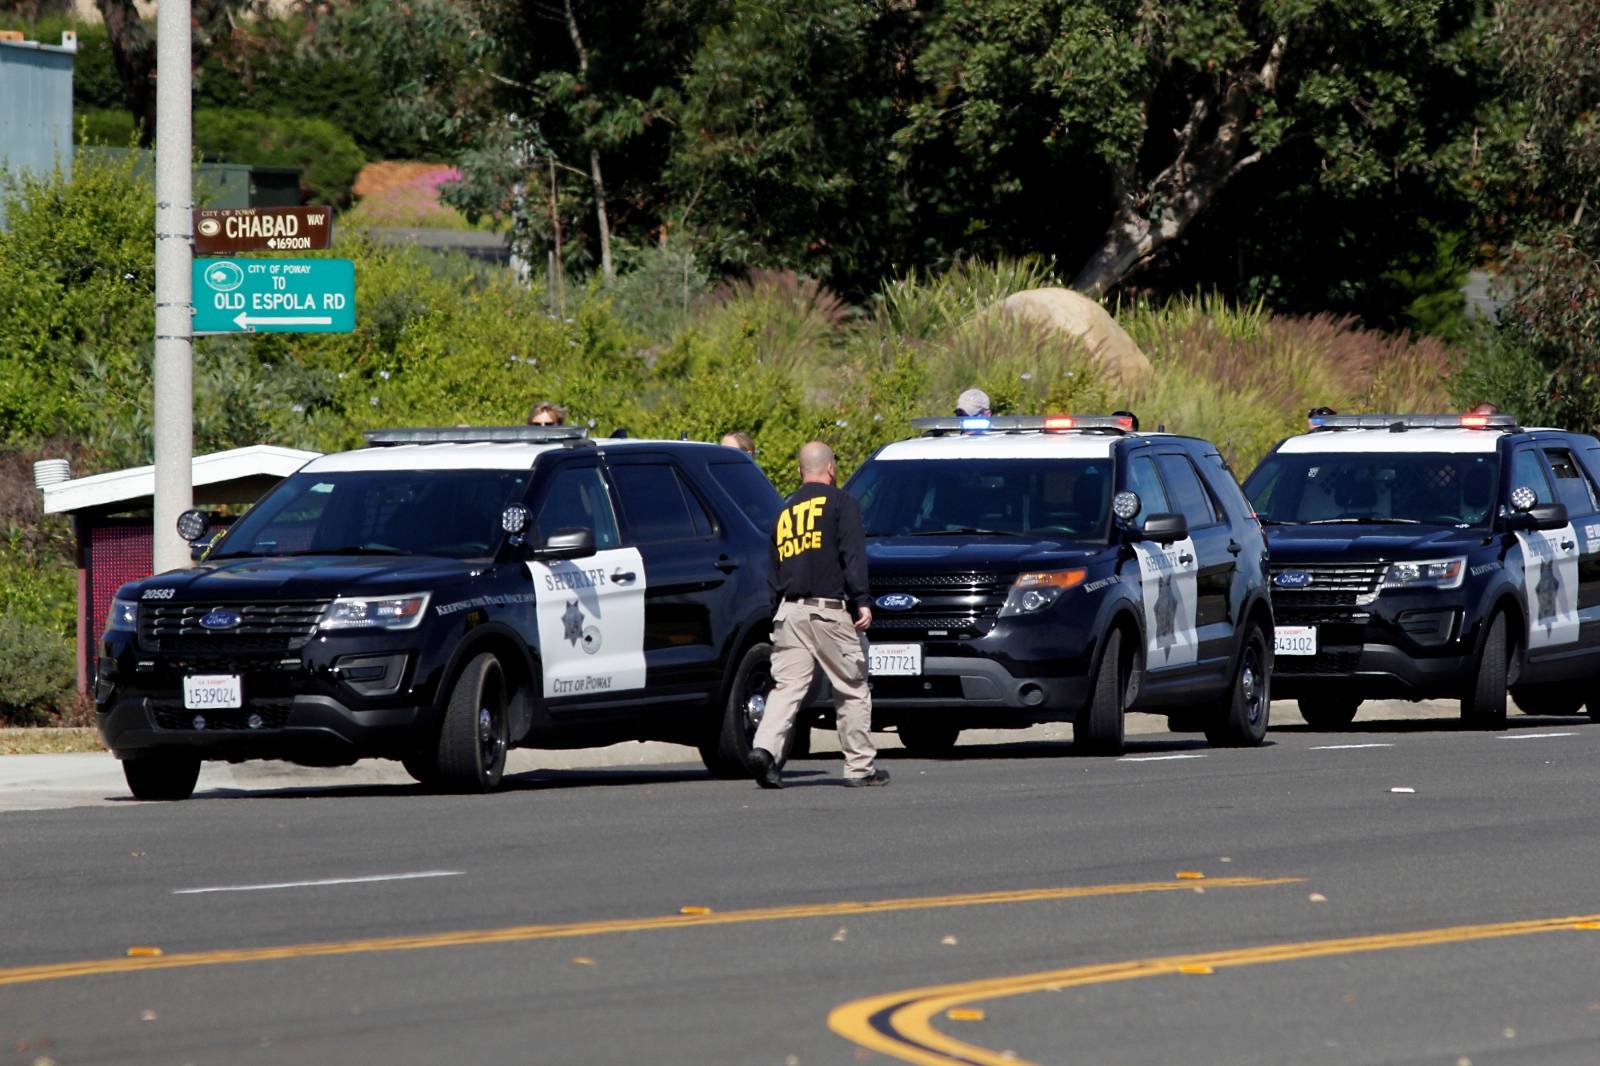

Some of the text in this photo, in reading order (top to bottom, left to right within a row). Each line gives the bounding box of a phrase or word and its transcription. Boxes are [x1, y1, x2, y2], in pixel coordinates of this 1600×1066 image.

[235, 208, 256, 216] POWAY
[225, 214, 325, 239] CHABAD WAY
[276, 238, 311, 249] 16900N
[248, 265, 266, 273] CITY
[270, 265, 280, 274] OF
[284, 265, 311, 274] POWAY
[272, 276, 286, 290] TO
[214, 293, 346, 310] OLD ESPOLA RD
[777, 496, 827, 546] ATF
[545, 568, 605, 591] SHERIFF
[1281, 574, 1305, 584] Ford
[142, 588, 176, 600] 20583
[884, 595, 909, 606] Ford
[206, 614, 231, 625] Ford
[869, 655, 916, 671] 1377721
[189, 687, 236, 704] 1539024
